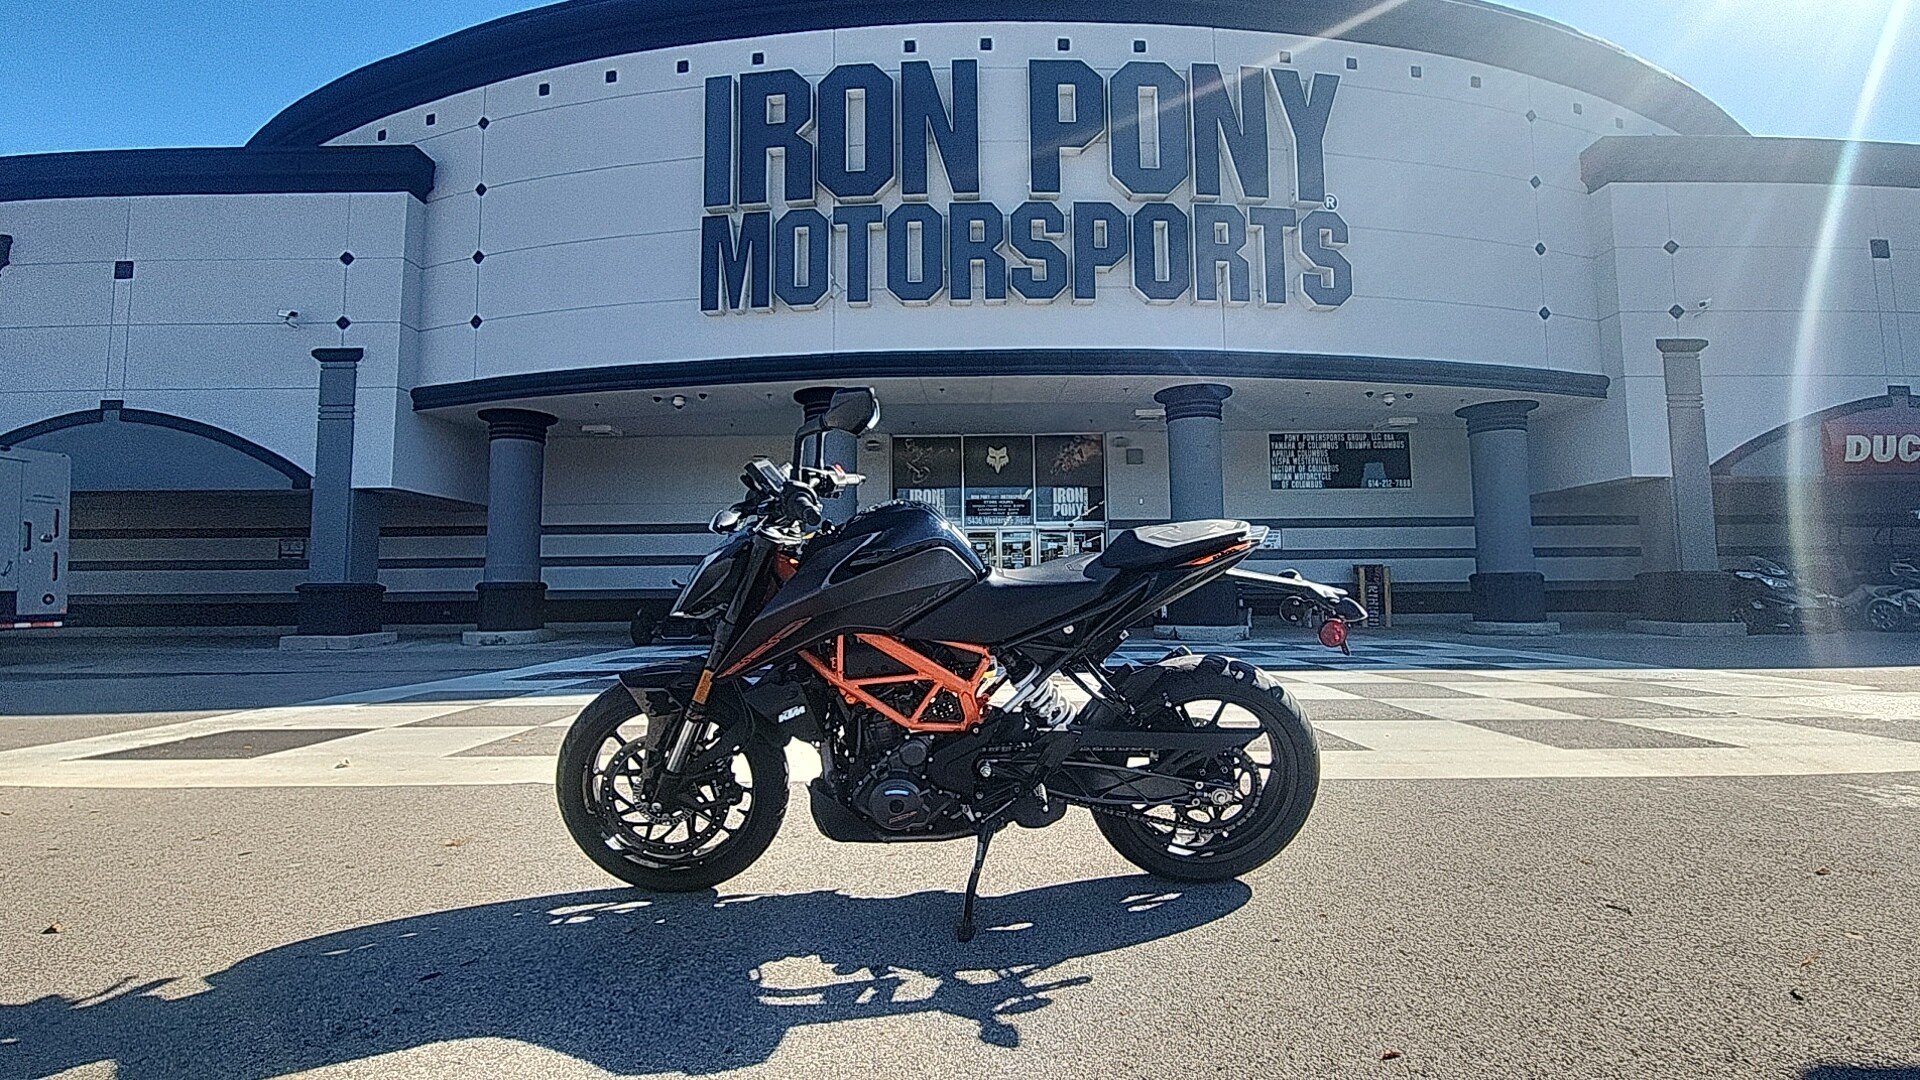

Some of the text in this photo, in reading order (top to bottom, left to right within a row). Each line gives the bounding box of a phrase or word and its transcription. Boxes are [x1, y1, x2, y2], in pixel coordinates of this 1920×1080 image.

[703, 58, 1341, 212] IRON PONY
[701, 201, 1353, 314] MOTORSPORTS
[1284, 434, 1300, 442] PONY
[1303, 433, 1345, 442] POWERSPORTS
[1371, 432, 1382, 441] LLC
[1271, 441, 1296, 450] YAMAHA
[1307, 441, 1339, 450] COLUMBUS
[1345, 440, 1405, 450] TRIUMPH COLUMBUS
[1297, 449, 1329, 457] COLUMBUS
[1271, 456, 1330, 465] VESPA WESTERVILLE
[1271, 464, 1340, 473] VICTORY OF COLUMBUS
[1271, 472, 1332, 481] INDIAN MOTORCYCLE
[1281, 480, 1323, 489] OF COLUMBUS
[909, 488, 940, 504] IRON
[1052, 487, 1084, 503] IRON
[1053, 503, 1084, 517] PONY
[778, 705, 806, 723] KTM
